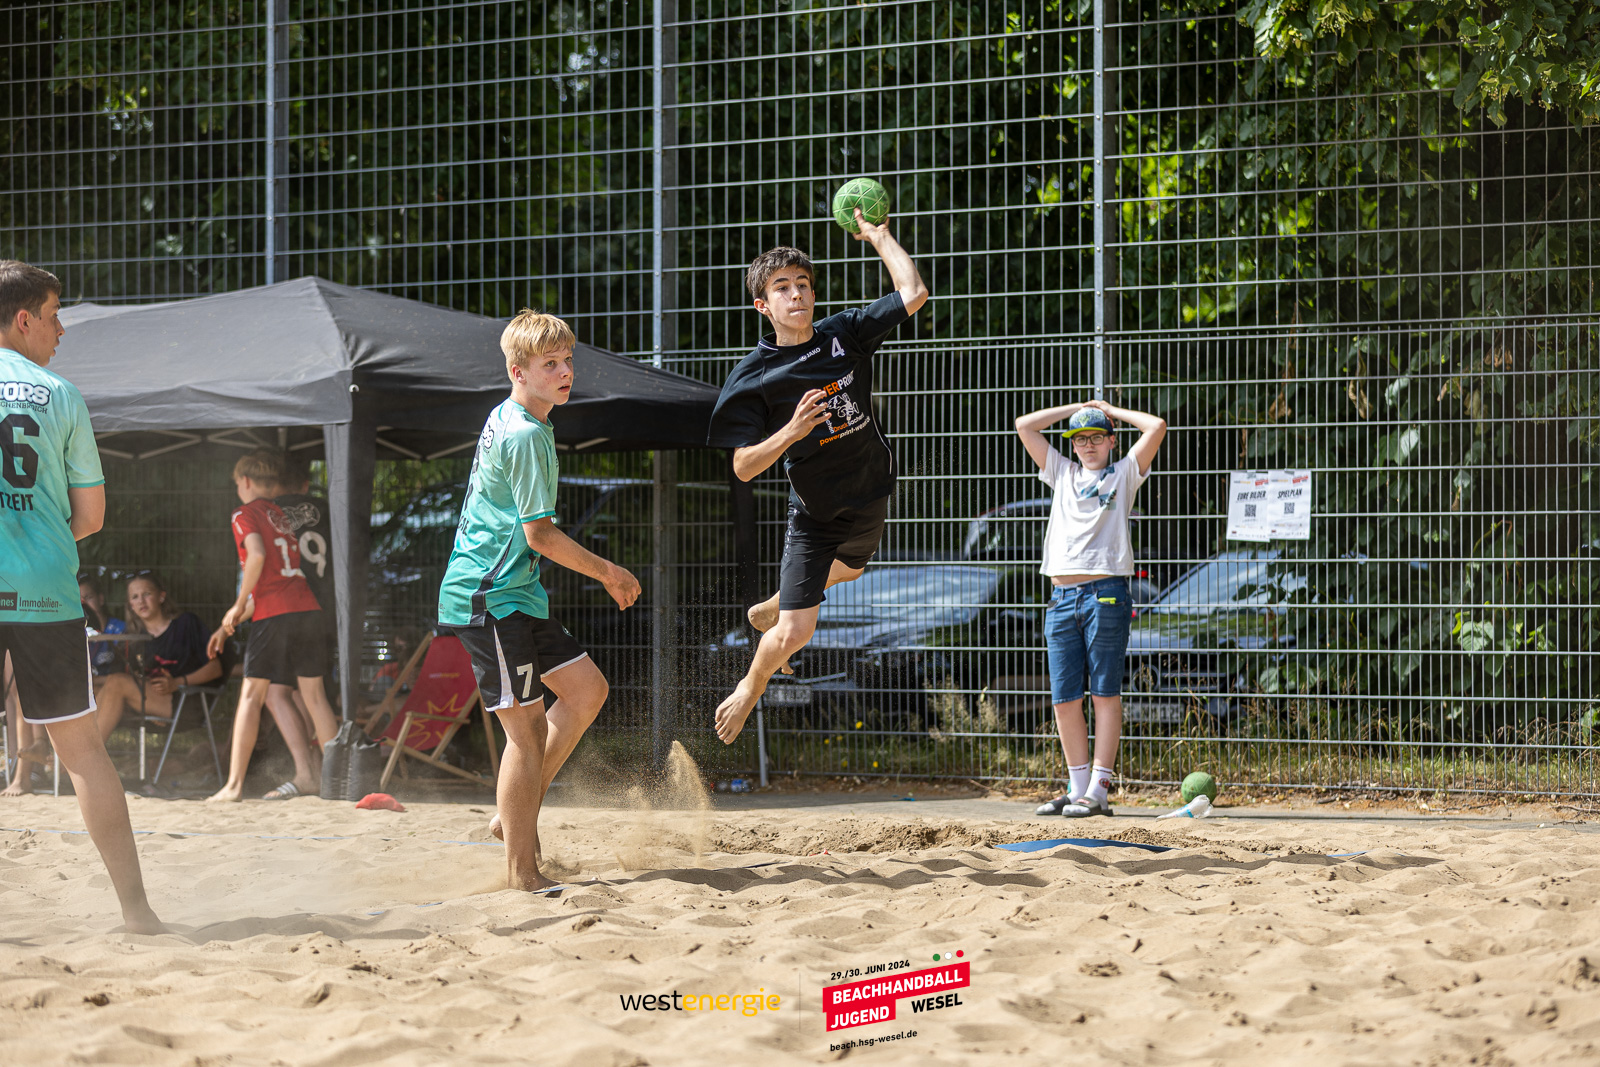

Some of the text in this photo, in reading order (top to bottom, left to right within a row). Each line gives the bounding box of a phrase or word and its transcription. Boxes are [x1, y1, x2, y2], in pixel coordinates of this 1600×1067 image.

[806, 347, 821, 358] JAKO
[831, 337, 845, 358] 4
[0, 414, 40, 488] 6
[299, 531, 328, 578] 9
[516, 662, 533, 699] 7
